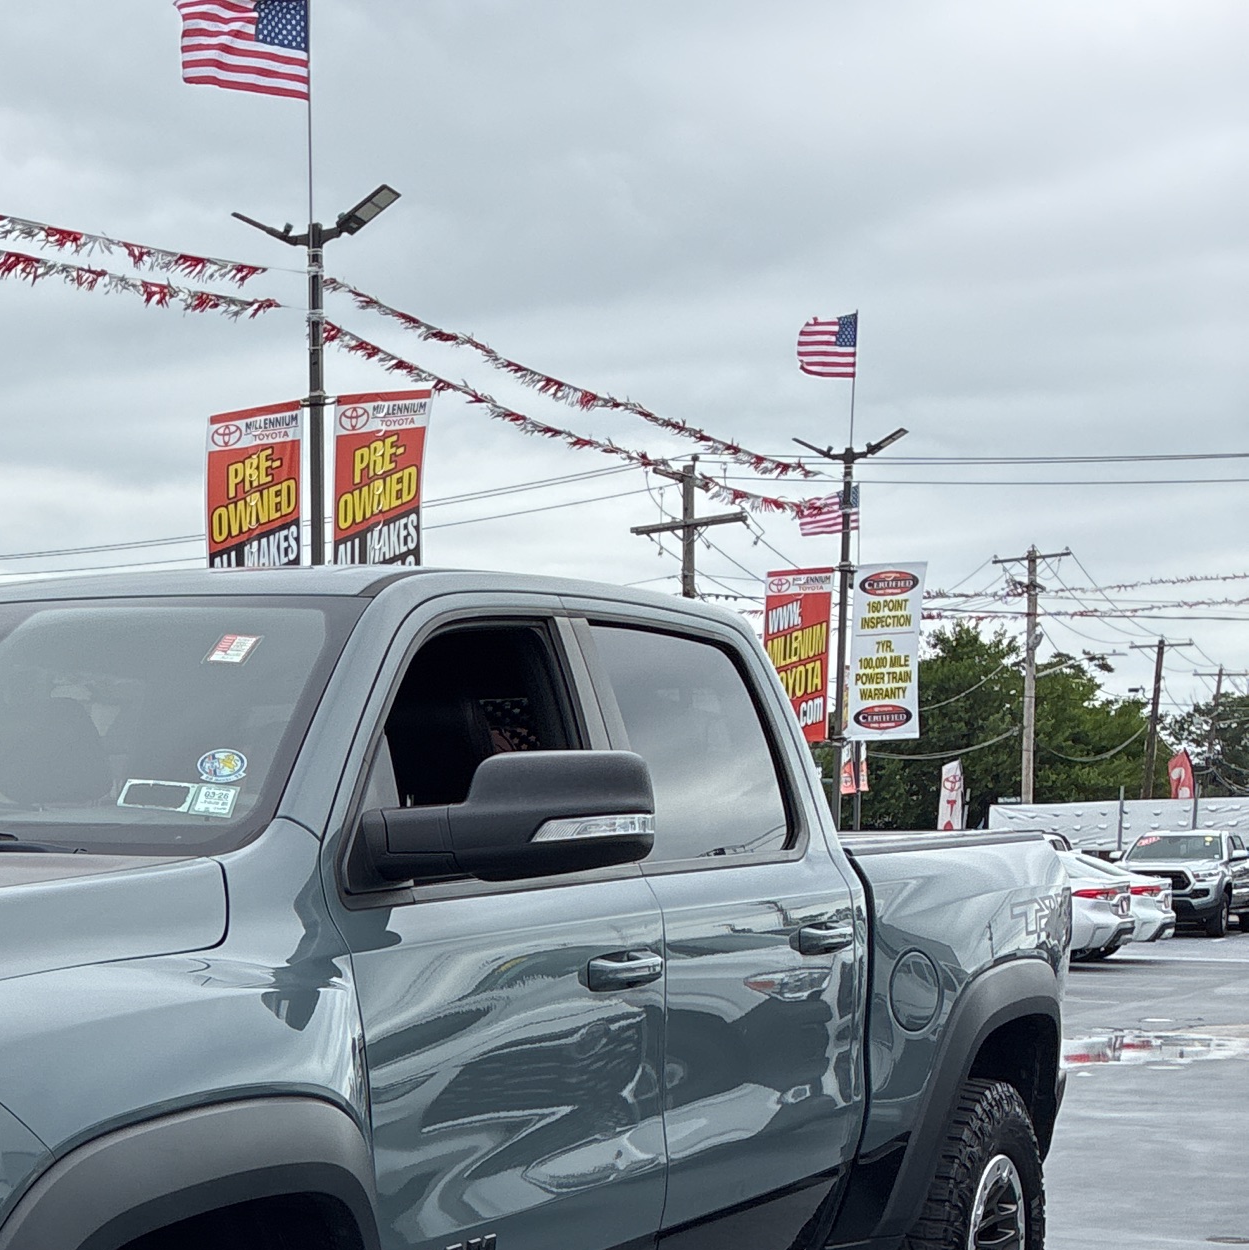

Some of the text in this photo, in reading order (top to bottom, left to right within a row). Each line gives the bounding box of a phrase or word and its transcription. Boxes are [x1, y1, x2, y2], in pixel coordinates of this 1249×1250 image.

[245, 413, 299, 433] MILLENNIUM
[381, 417, 416, 427] TOYOTA
[253, 430, 290, 442] TOYOTA
[353, 434, 406, 485] PRE-
[228, 447, 281, 498] PRE-
[337, 465, 418, 530] OWNED
[212, 480, 297, 544] OWNED
[244, 525, 299, 567] MAKES
[866, 599, 909, 614] 160 POINT
[860, 614, 912, 630] INSPECTION
[889, 655, 910, 668] MILE
[779, 660, 821, 700] OYOTA
[854, 670, 912, 686] POWER TRAIN
[859, 686, 907, 701] WARRANTY
